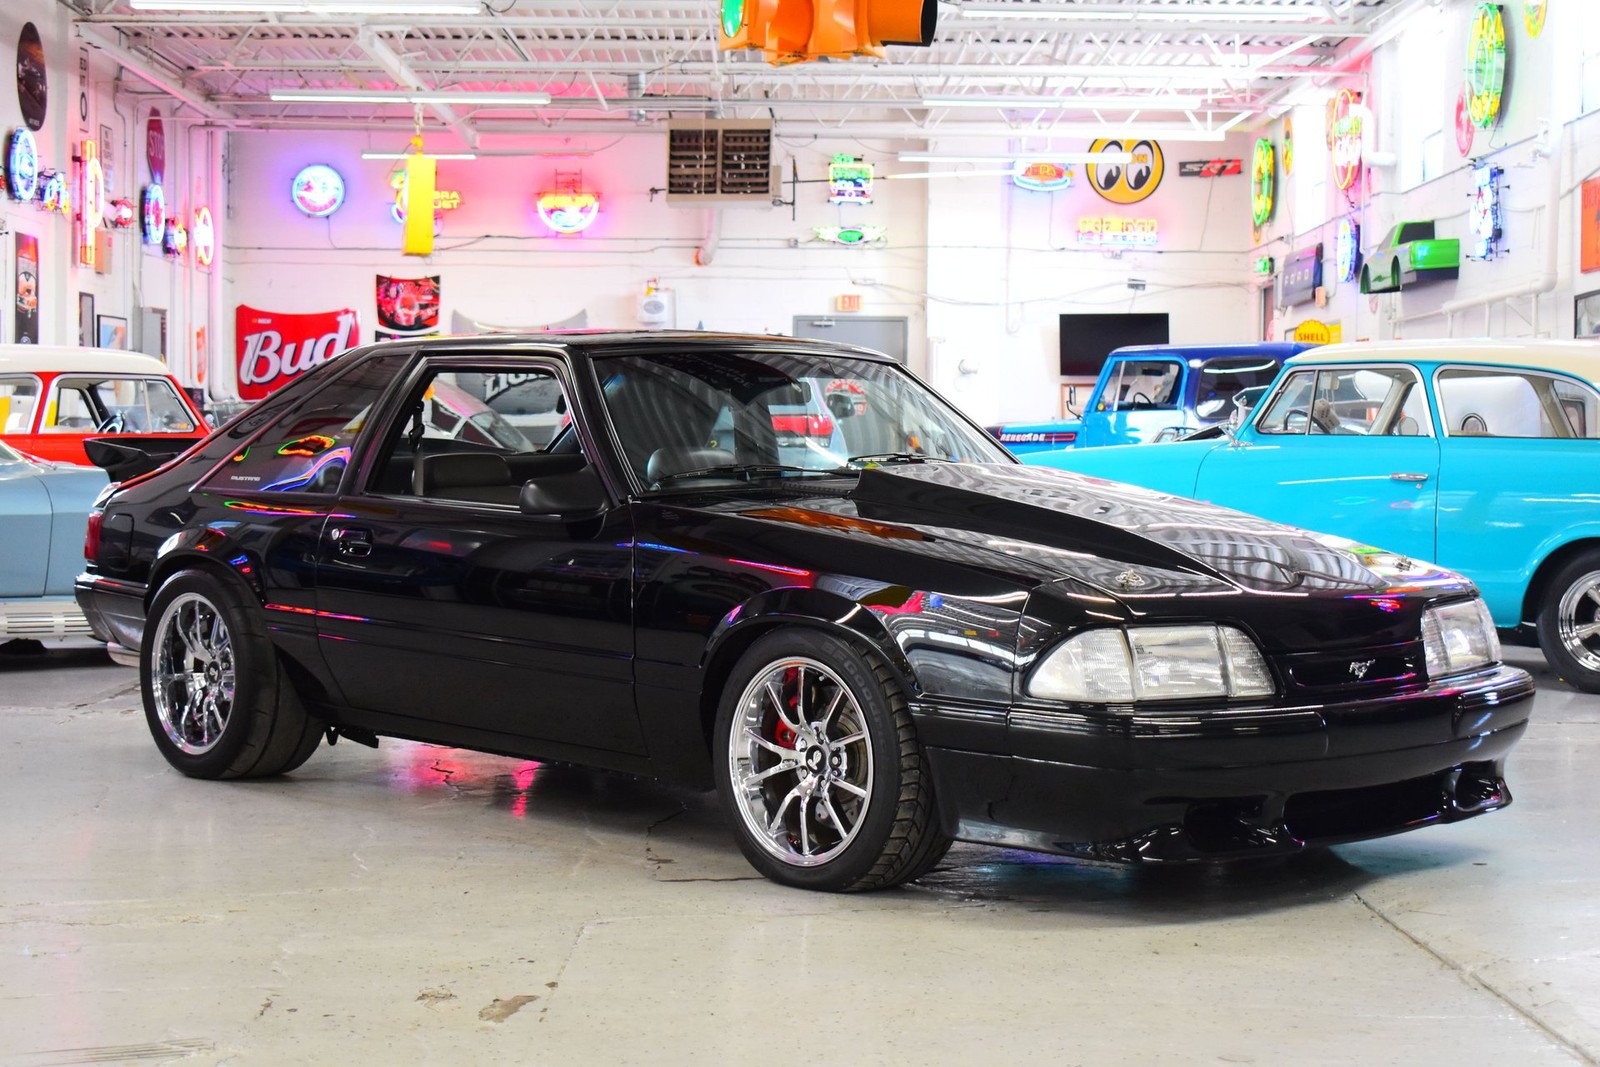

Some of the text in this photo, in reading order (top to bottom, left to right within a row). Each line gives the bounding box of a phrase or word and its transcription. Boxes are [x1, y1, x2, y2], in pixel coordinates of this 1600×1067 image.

[434, 190, 460, 200] BRA
[1284, 268, 1310, 285] FORD
[841, 295, 861, 310] EXIT
[1298, 332, 1326, 341] SHELL
[240, 313, 353, 386] Bud
